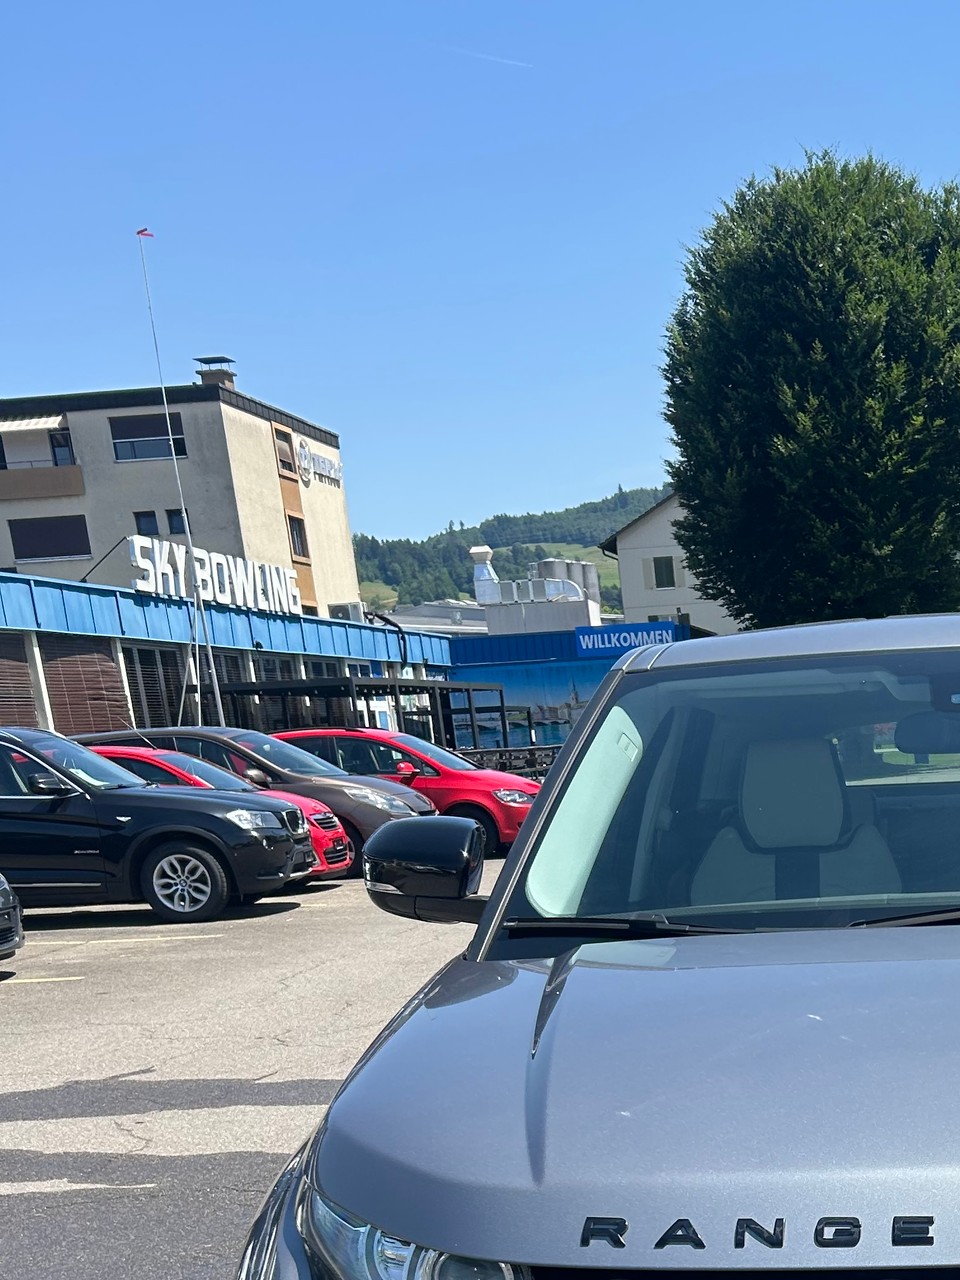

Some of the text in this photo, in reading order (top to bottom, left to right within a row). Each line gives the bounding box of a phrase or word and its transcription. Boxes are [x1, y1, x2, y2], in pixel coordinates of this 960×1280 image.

[130, 535, 302, 615] SKY BOWLING
[579, 629, 673, 650] WILLKOMMEN
[580, 1215, 935, 1249] RANGE
